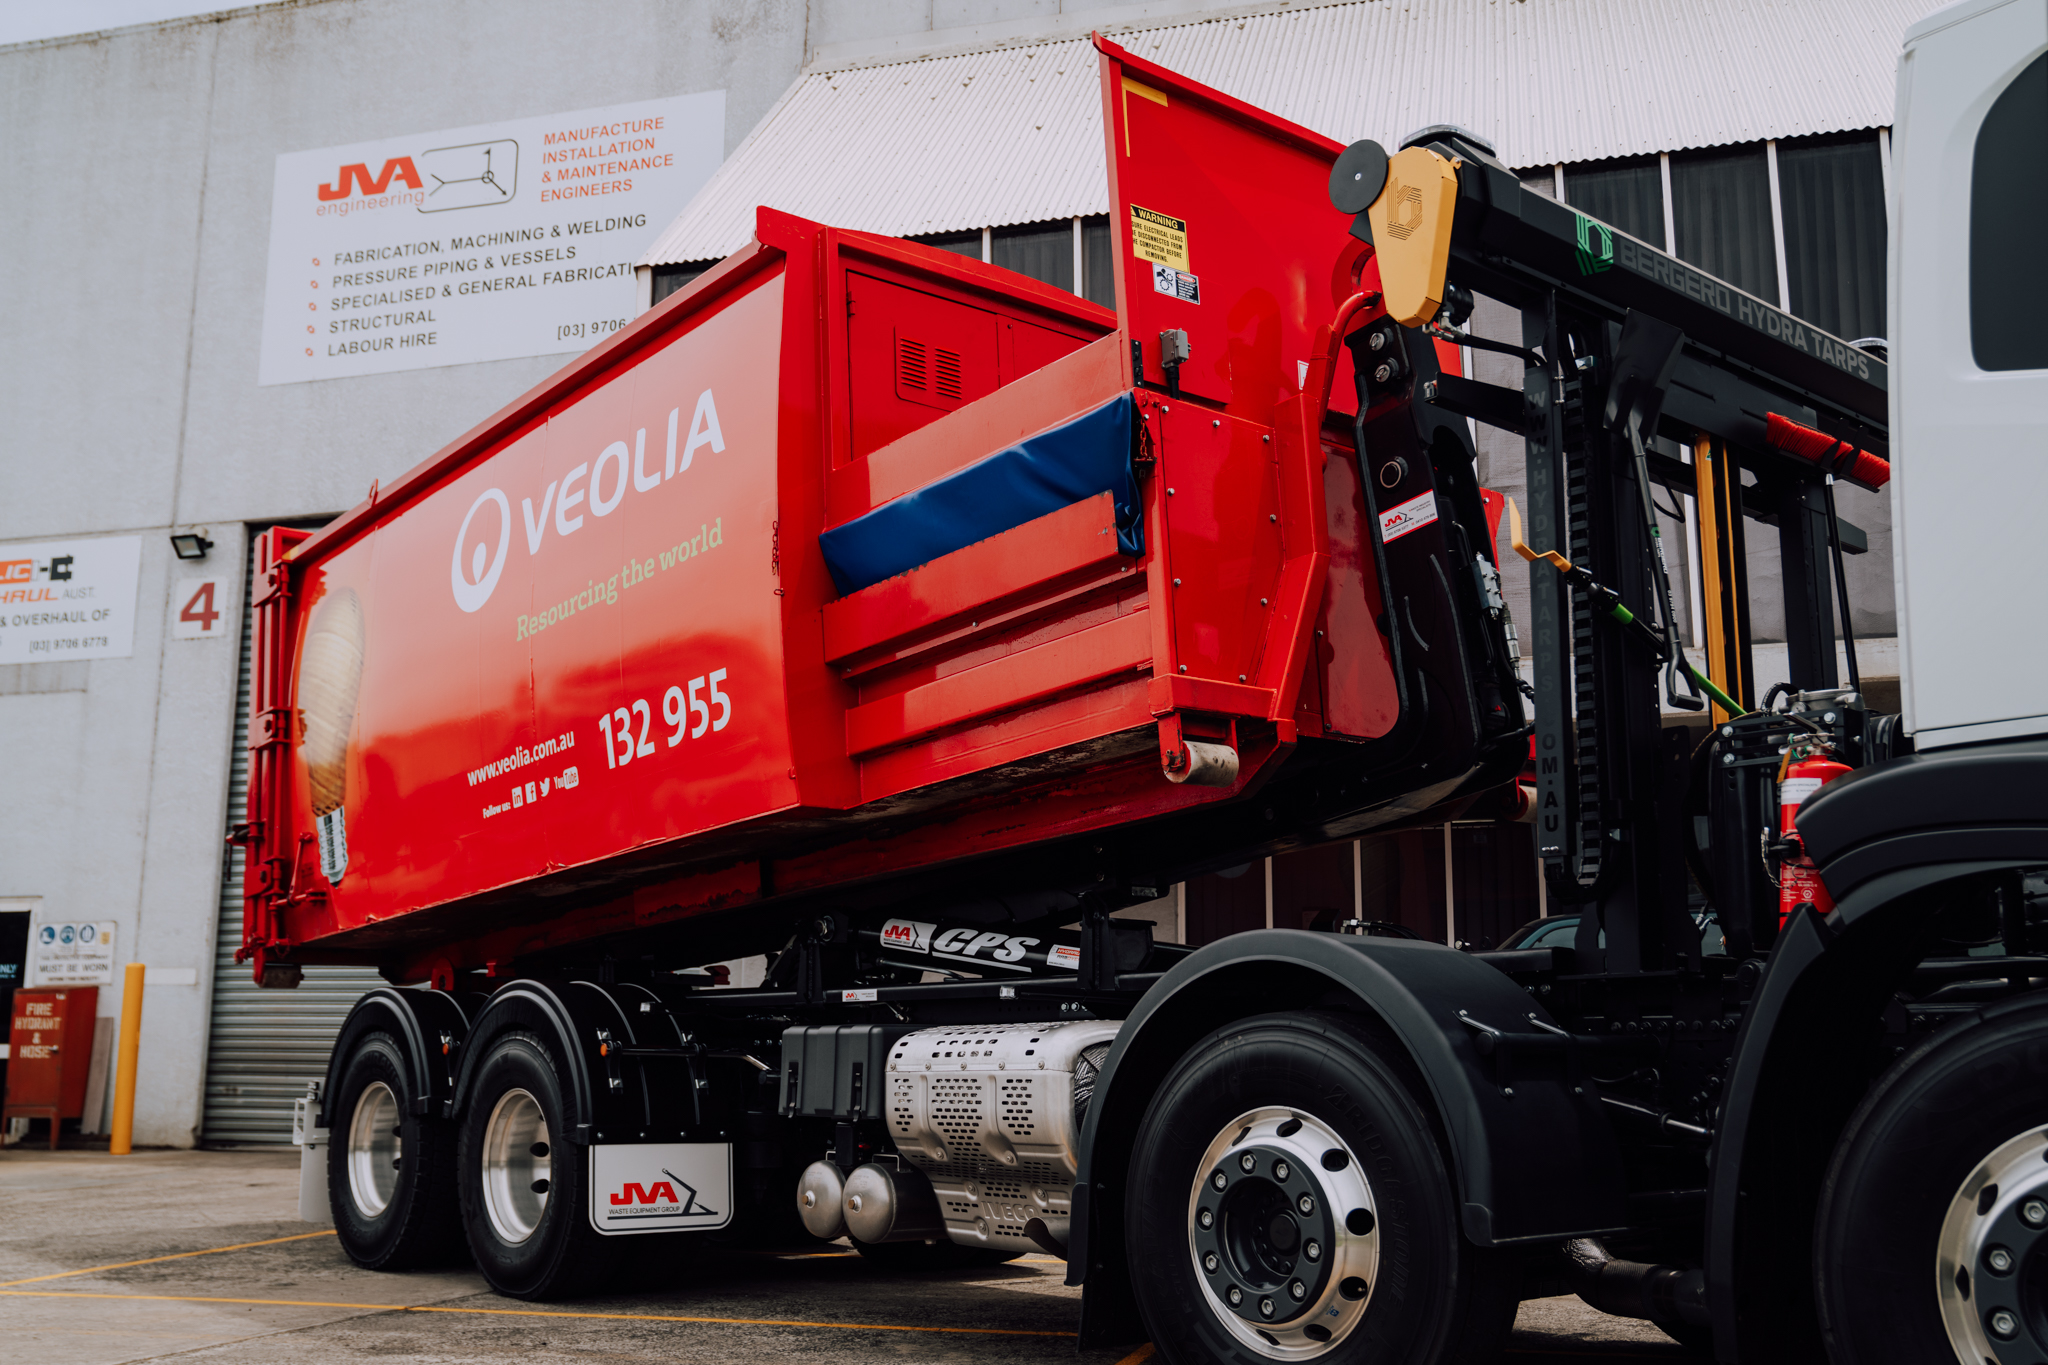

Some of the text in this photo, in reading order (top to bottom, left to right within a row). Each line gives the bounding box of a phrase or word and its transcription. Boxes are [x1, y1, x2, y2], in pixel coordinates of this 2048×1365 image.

[544, 117, 665, 145] MANUFACTURE
[542, 137, 655, 164] INSTALLATION
[317, 156, 424, 202] JVA
[541, 153, 674, 183] & MAINTENANCE
[540, 179, 633, 203] ENGINEERS
[316, 190, 425, 217] engineering
[1137, 208, 1179, 230] WARNING
[334, 213, 646, 266] FABRICATION, MACHINING & WELDING
[1138, 230, 1170, 247] DISCONNECTED
[1170, 241, 1183, 250] FROM
[1143, 224, 1169, 239] ELECTRICAL
[1169, 232, 1184, 243] LEADS
[1139, 239, 1165, 254] COMPACTOR
[1166, 248, 1183, 259] BEFORE
[1145, 249, 1169, 263] REMOVING.
[332, 246, 576, 289] PRESSURE PIPING & VESSELS
[330, 262, 633, 311] SPECIALISED & GENERAL FABRICATI
[1619, 237, 1869, 380] BERGERO HYDRA TARPS
[329, 309, 436, 334] STRUCTURAL
[557, 318, 626, 340] [03] 9706
[327, 332, 437, 357] LABOUR HIRE
[521, 388, 726, 556] VEOLIA
[1384, 514, 1403, 528] JVA
[516, 517, 723, 642] Resourcing the world
[12, 610, 87, 626] OVERHAUL
[91, 609, 110, 621] OF
[179, 582, 219, 631] 4
[29, 639, 50, 654] [03]
[53, 638, 78, 650] 9706
[598, 667, 732, 770] 132 955
[467, 730, 575, 787] www.veolia.com.au
[482, 801, 511, 819] Follow us:
[884, 925, 911, 941] JVA
[933, 928, 1041, 962] CPS
[39, 962, 108, 973] MUST BE WORN
[26, 1002, 54, 1016] FIRE
[15, 1017, 62, 1031] HYDRANT
[32, 1031, 41, 1045] &
[610, 1181, 679, 1206] JVA
[608, 1205, 681, 1215] WASTE EQUIPMENT GROUP
[980, 1200, 1039, 1222] IVECO
